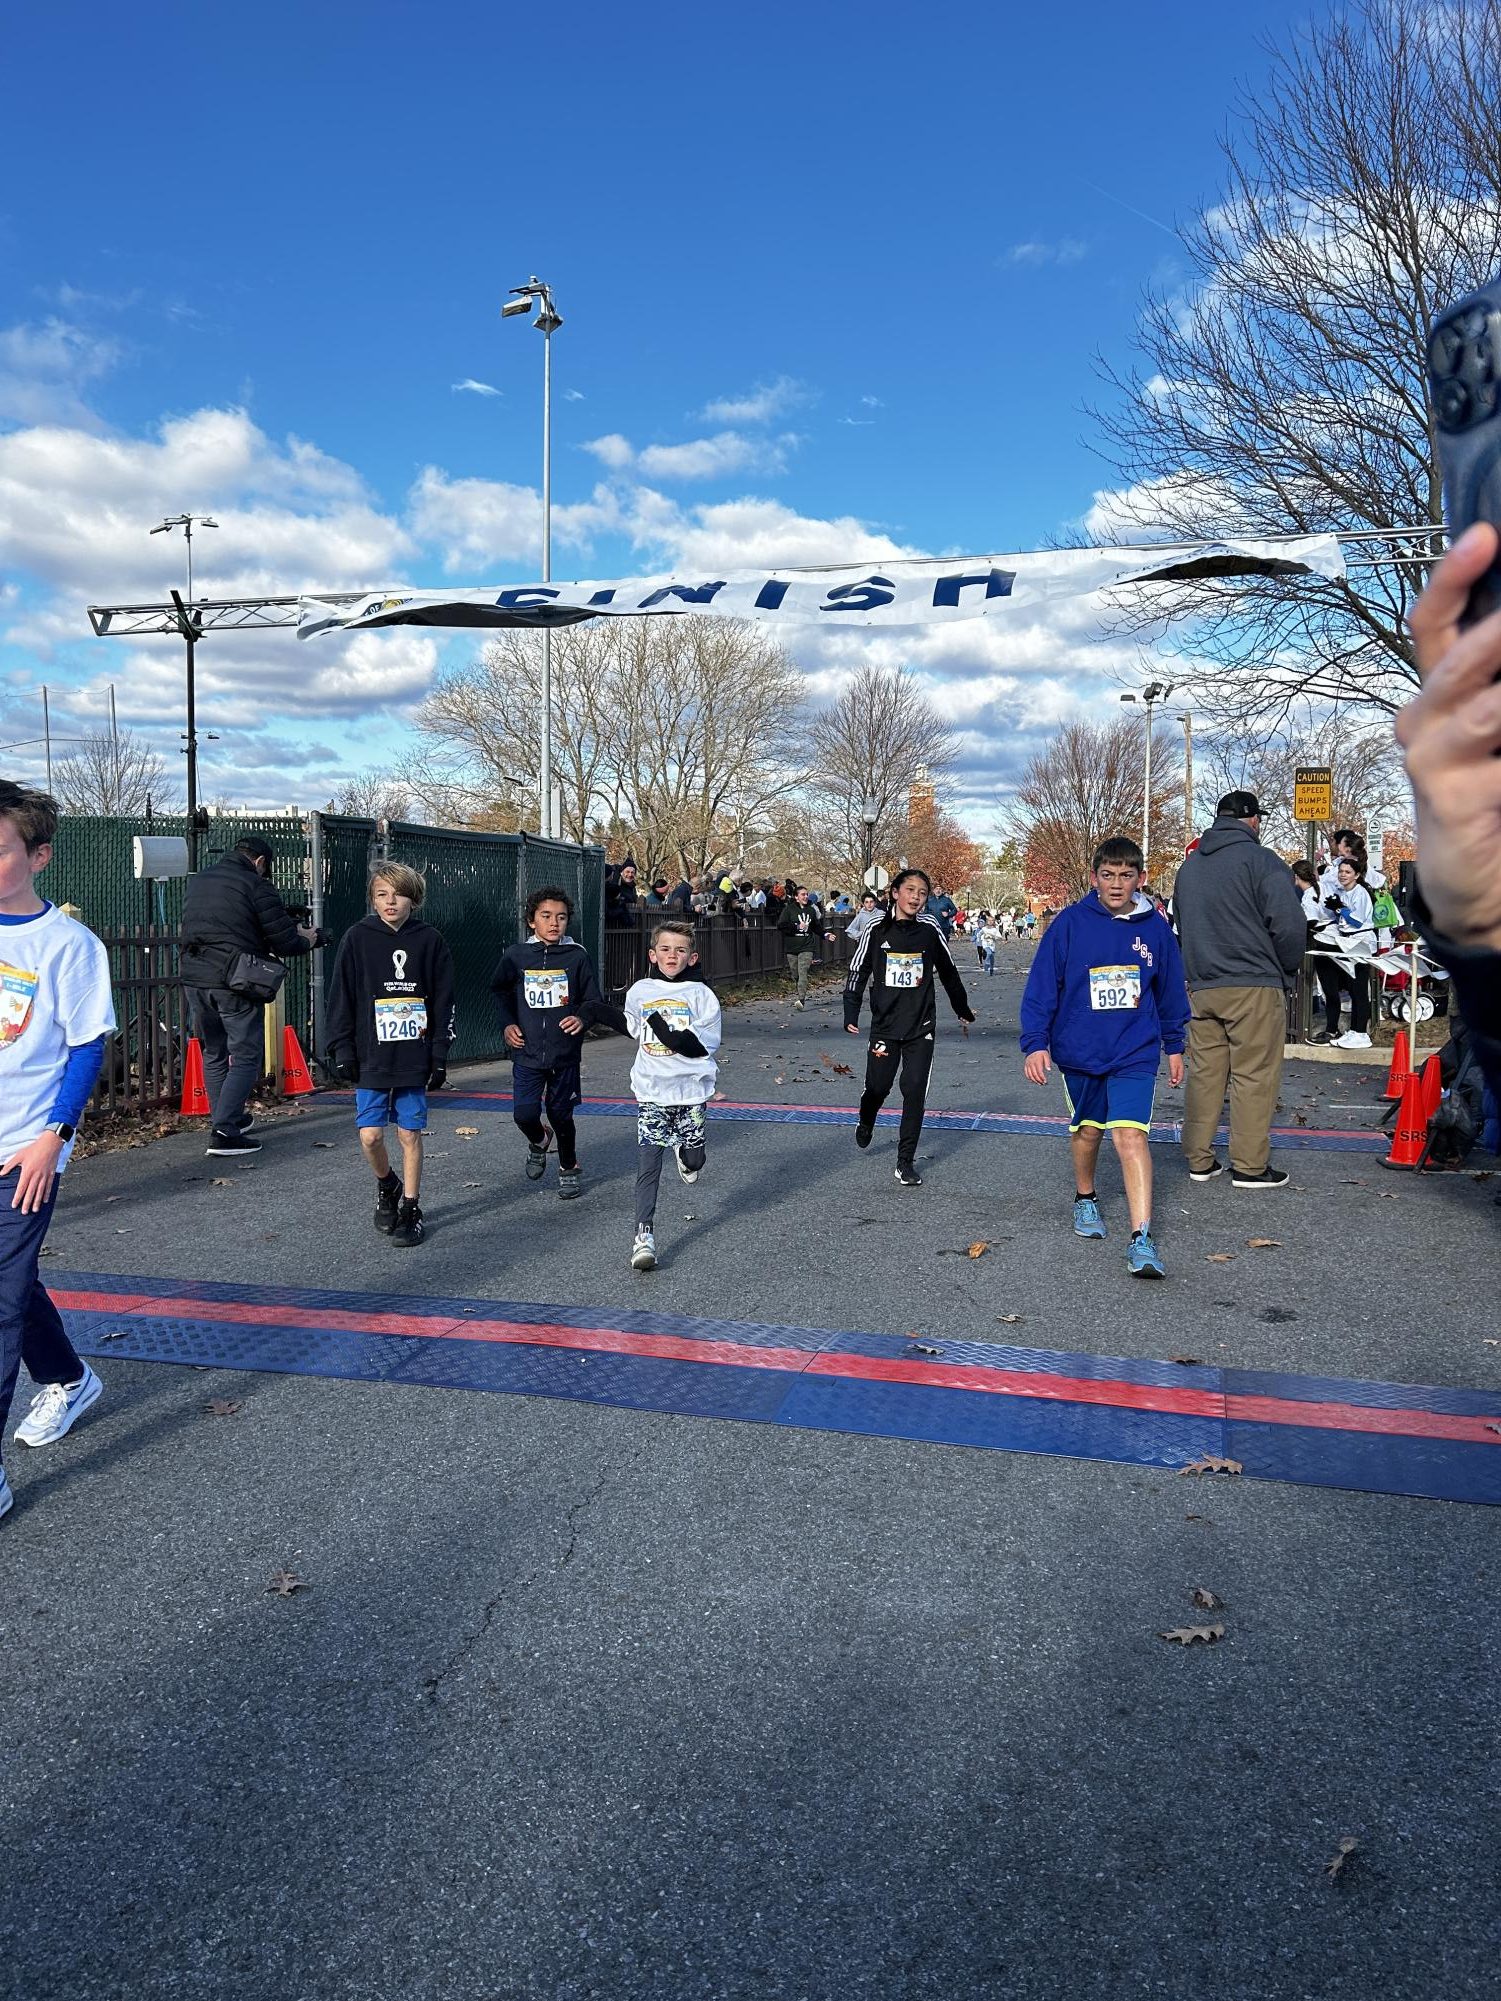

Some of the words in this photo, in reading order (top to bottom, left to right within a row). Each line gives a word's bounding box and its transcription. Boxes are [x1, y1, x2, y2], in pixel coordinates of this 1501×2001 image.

[1297, 773, 1330, 781] CAUTION
[1301, 786, 1324, 794] SPEED
[891, 971, 912, 986] 143
[529, 990, 552, 1006] 941
[1098, 988, 1127, 1007] 592
[380, 1020, 417, 1040] 1246
